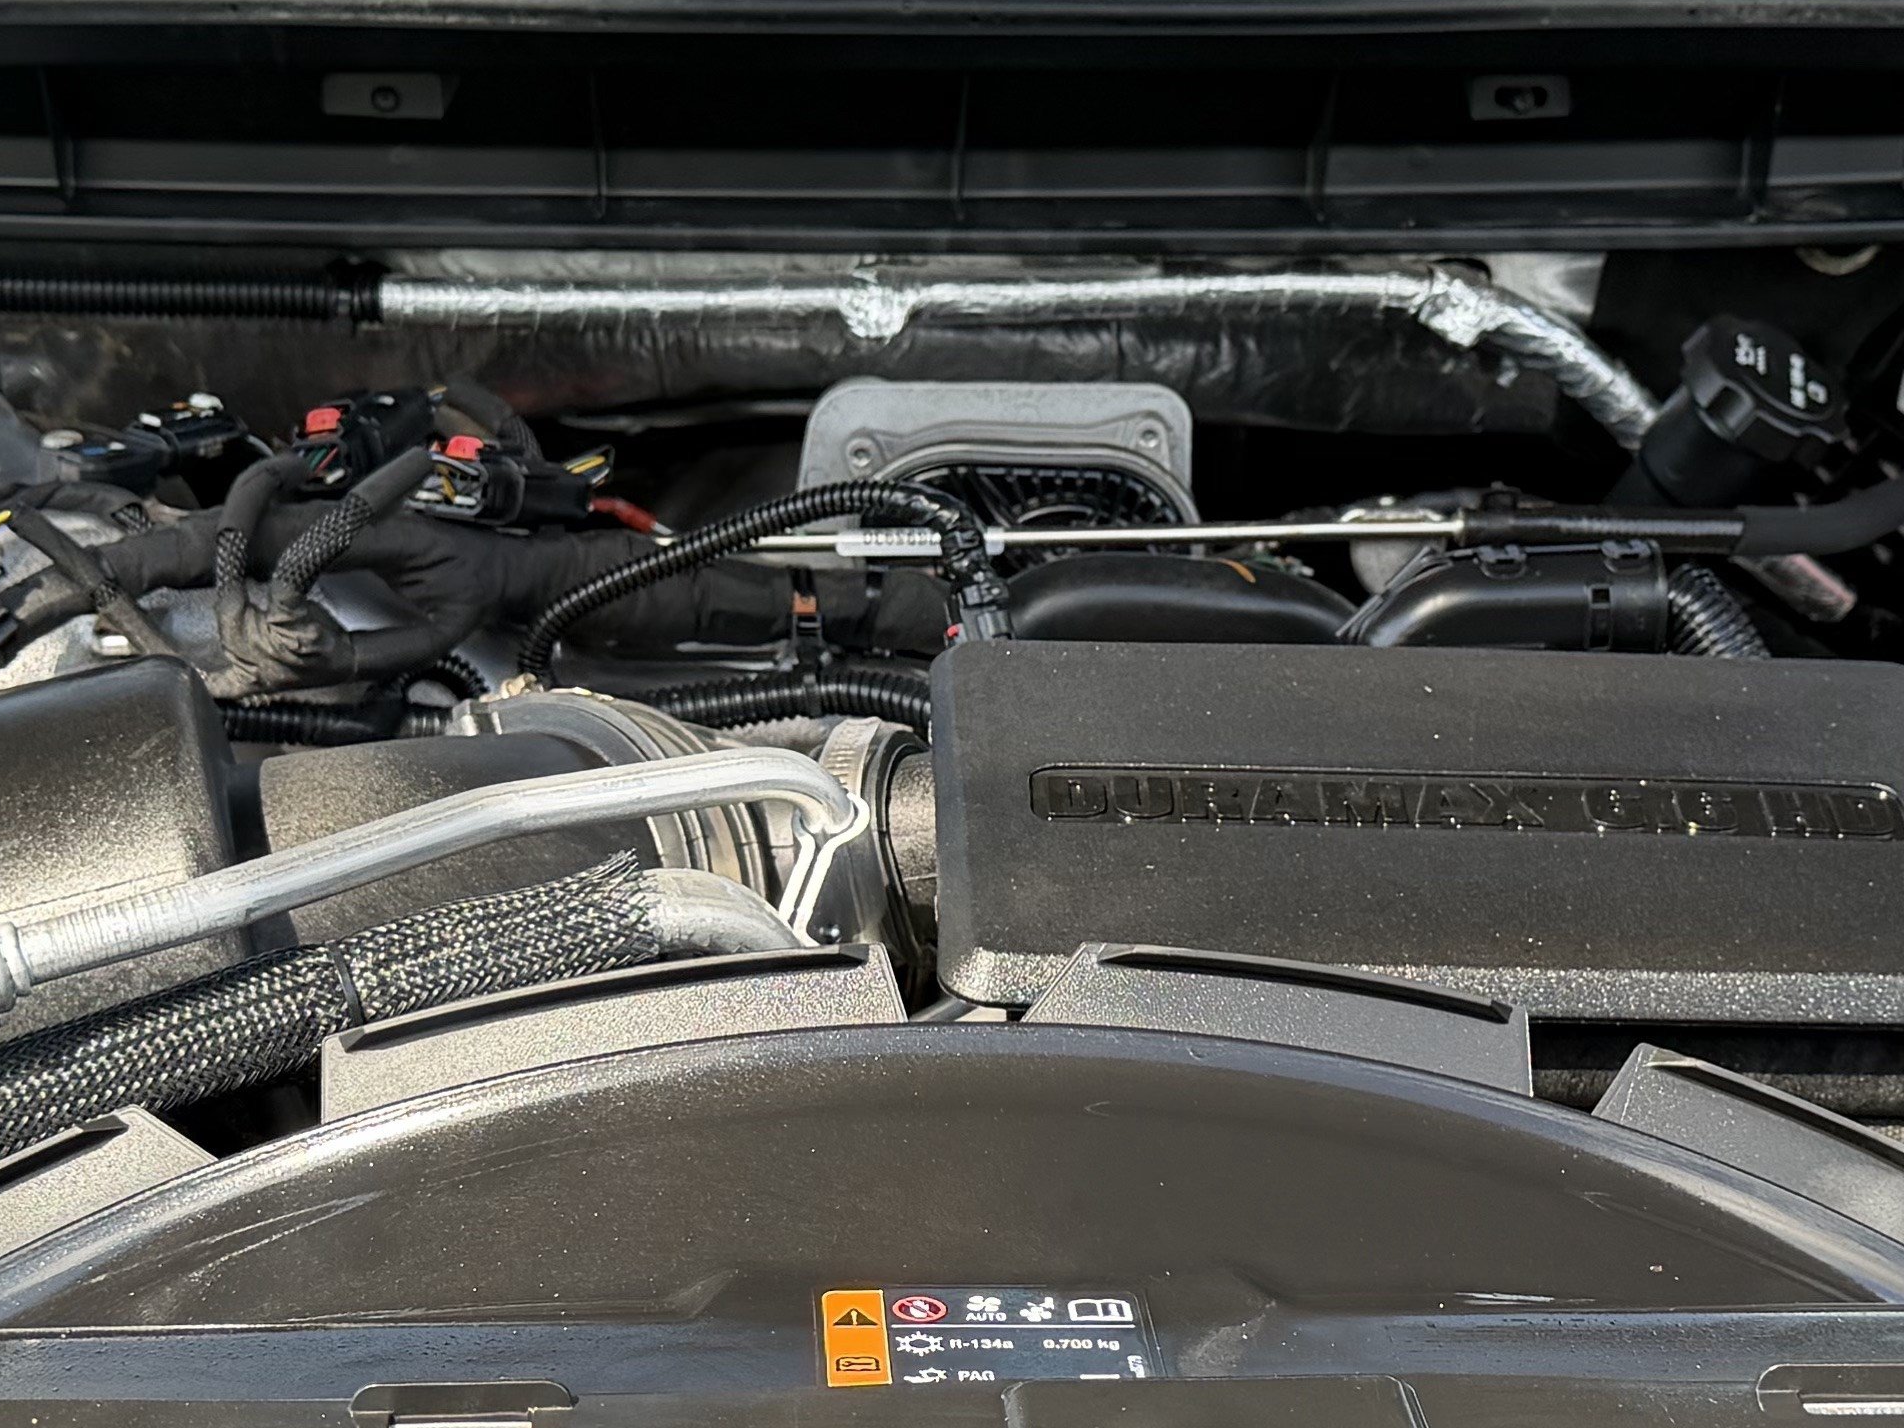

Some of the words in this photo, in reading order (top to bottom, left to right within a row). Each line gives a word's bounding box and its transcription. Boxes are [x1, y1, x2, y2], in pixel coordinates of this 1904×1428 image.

[1047, 775, 1545, 828] DURAMAX
[1760, 791, 1895, 839] HD
[965, 1311, 1007, 1322] AUTO
[949, 1339, 1014, 1350] R-134a
[1043, 1339, 1093, 1350] 0.700
[1097, 1339, 1120, 1351] kg
